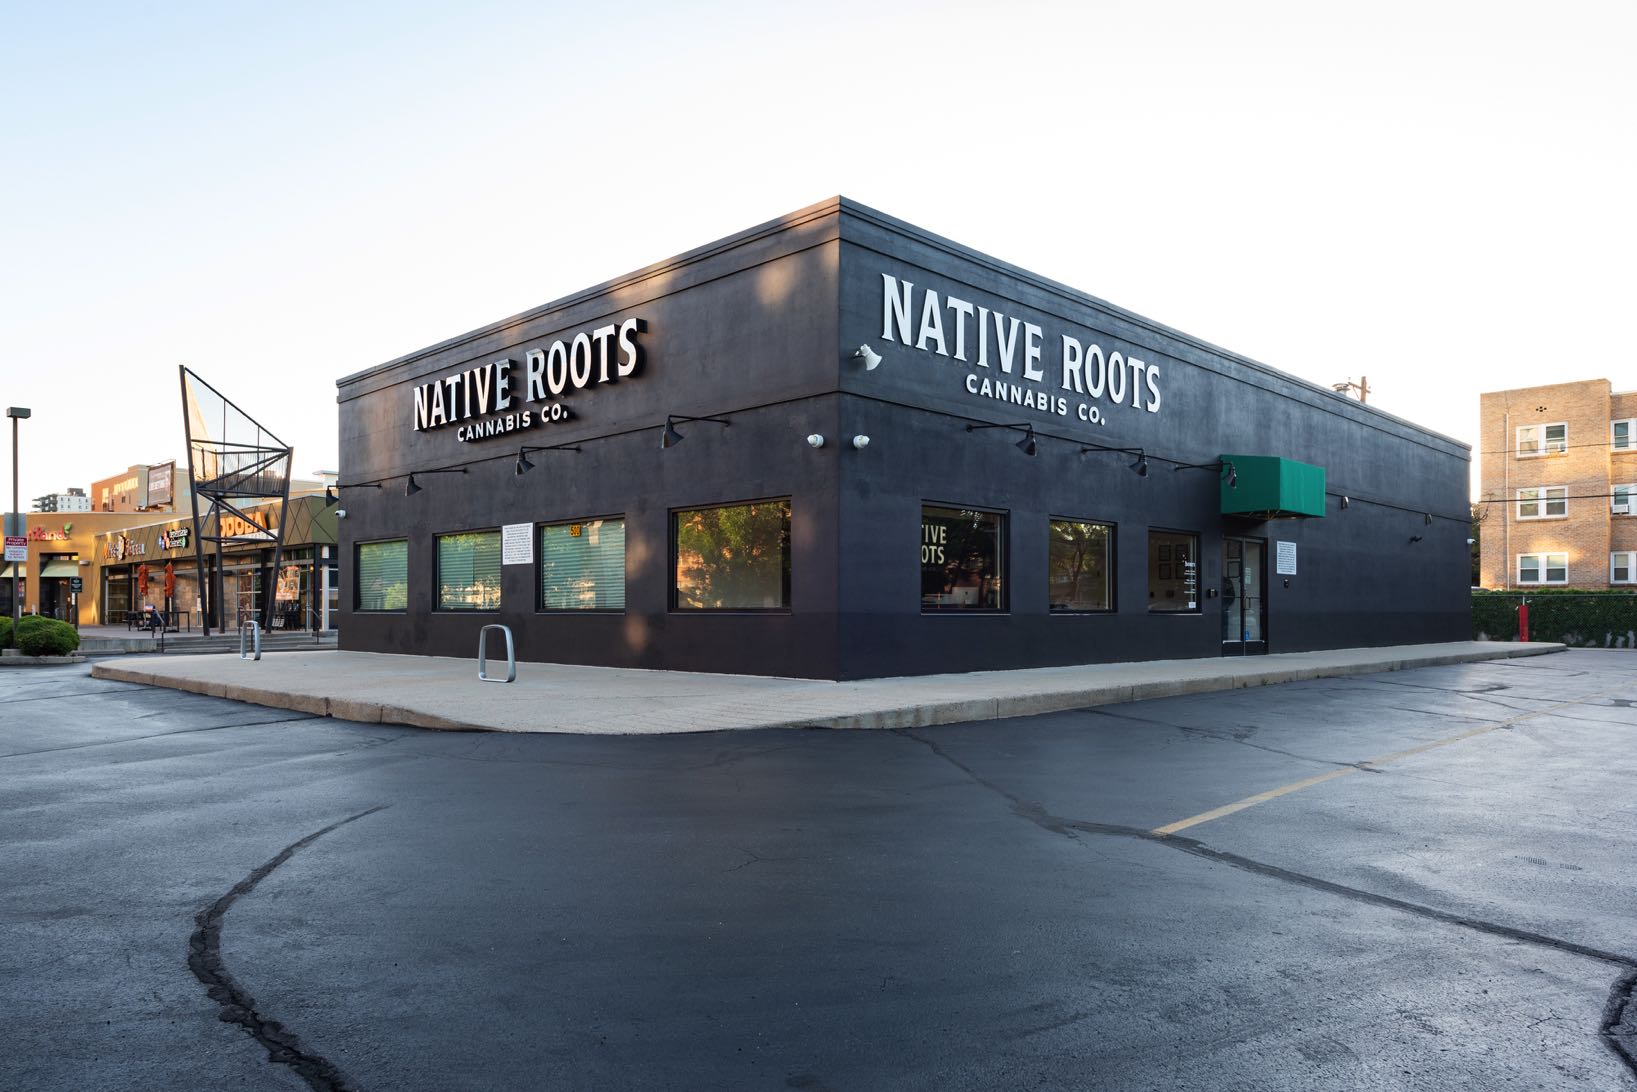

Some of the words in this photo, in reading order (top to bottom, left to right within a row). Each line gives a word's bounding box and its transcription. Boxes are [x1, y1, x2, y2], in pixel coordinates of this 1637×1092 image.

[881, 272, 1044, 382] NATIVE
[1061, 334, 1161, 413] ROOTS
[413, 358, 512, 431] NATIVE
[526, 318, 639, 403] ROOTS
[457, 410, 531, 442] CANNABIS
[541, 403, 568, 423] CO.
[966, 374, 1068, 416] CANNABIS
[1078, 403, 1106, 426] CO.
[921, 524, 947, 544] IVE
[921, 545, 945, 564] OTS
